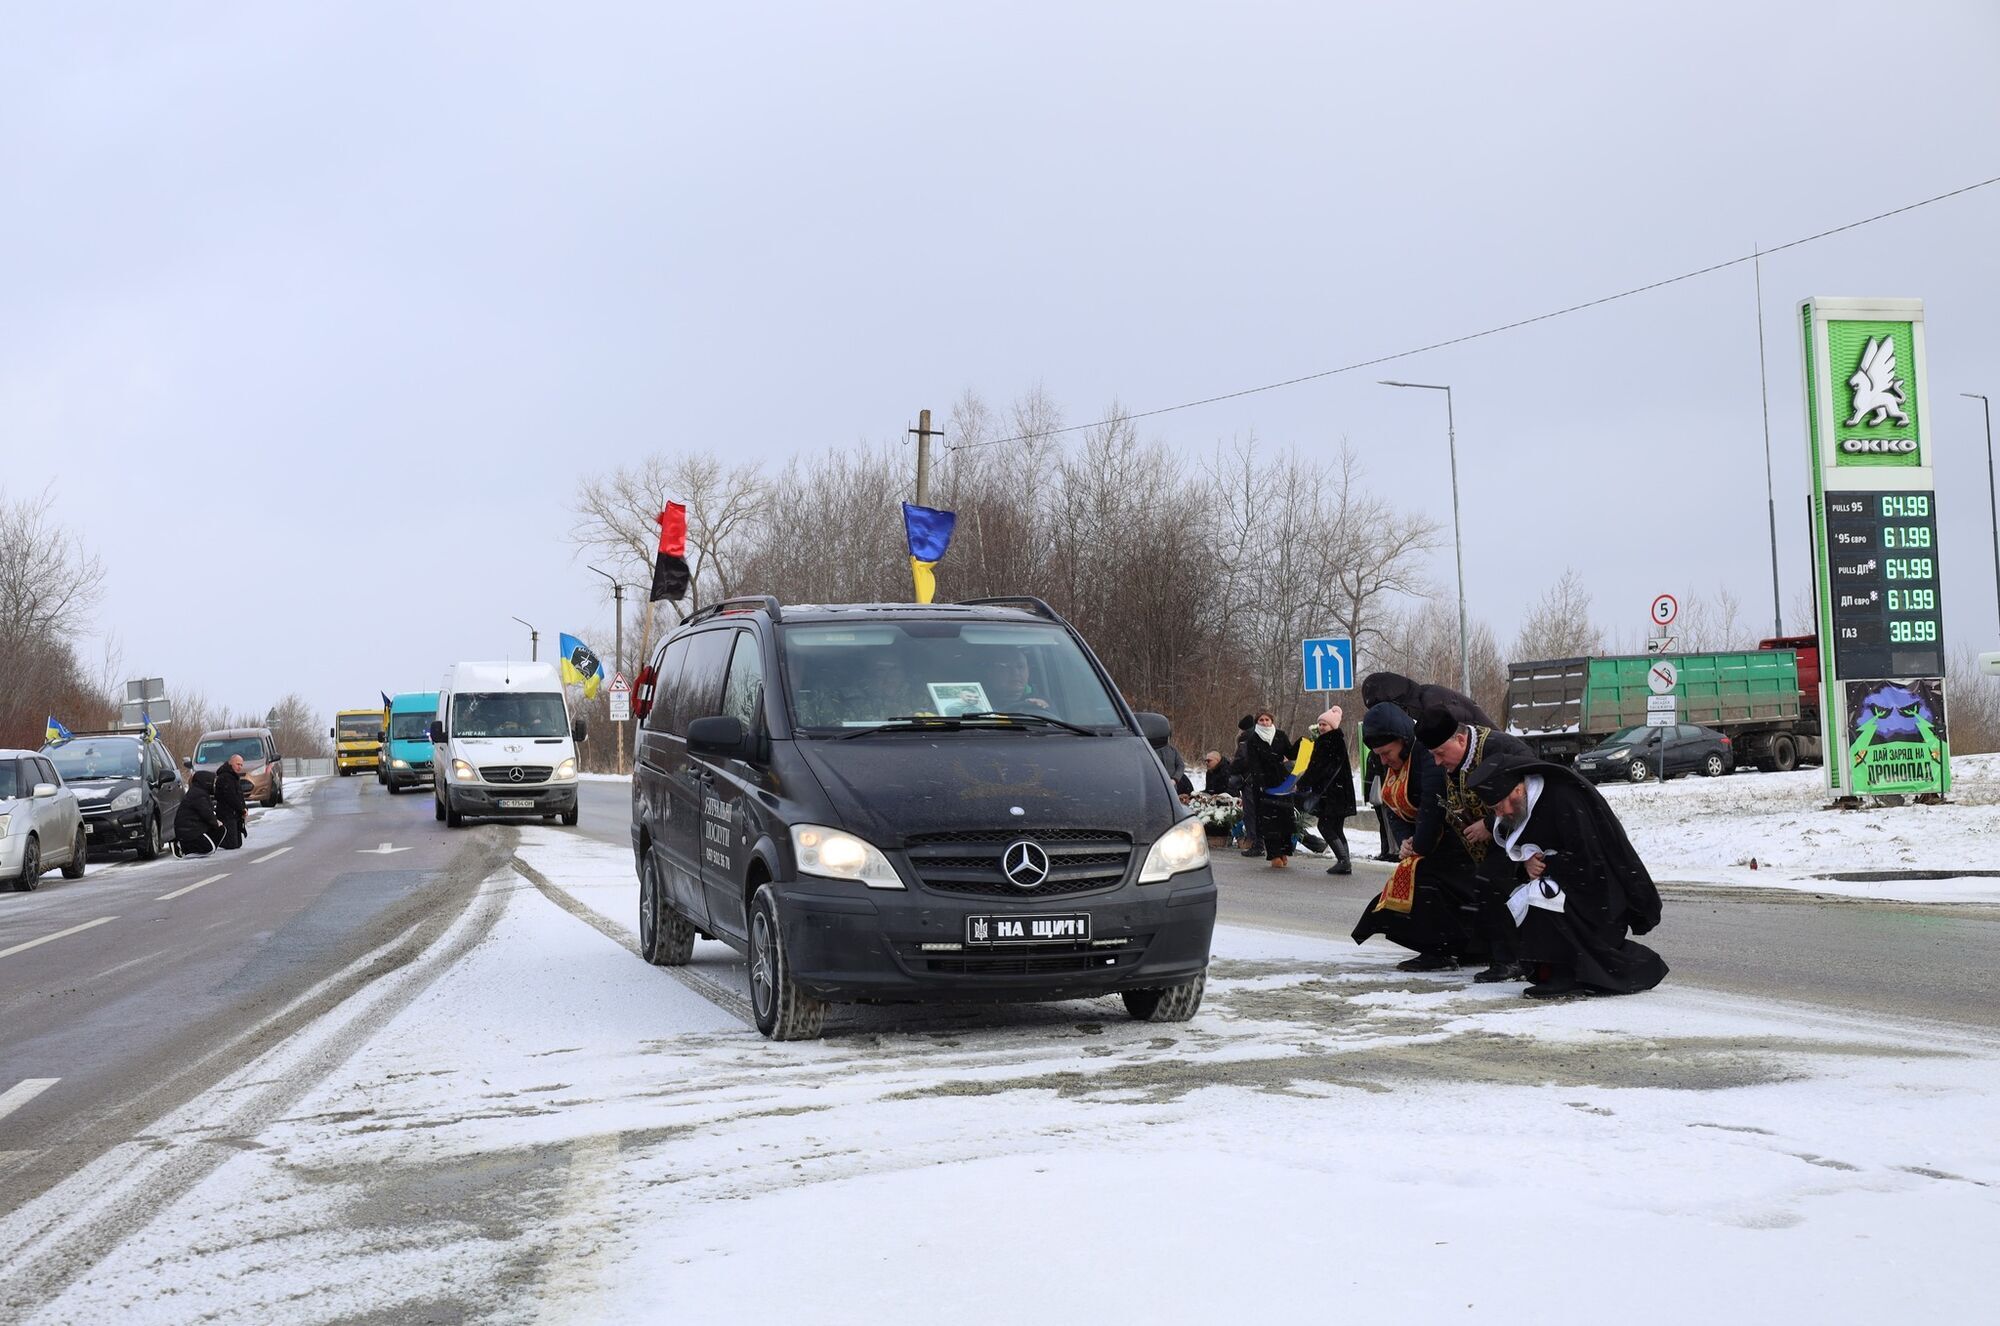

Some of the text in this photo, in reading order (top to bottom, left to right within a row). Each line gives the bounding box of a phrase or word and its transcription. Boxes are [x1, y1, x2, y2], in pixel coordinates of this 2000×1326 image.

[1843, 438, 1917, 453] OKKO
[1832, 496, 1928, 517] PULLS 95 64.99
[1884, 527, 1930, 548] 61.99
[1838, 559, 1932, 580] PULLS ДП 64.99
[1660, 602, 1669, 618] 5
[1841, 595, 1853, 607] ДП
[1888, 589, 1934, 610] 61.99
[1841, 621, 1936, 642] ГАЗ 38.99
[1873, 747, 1925, 761] ДАЙ ЗАРЯД НА
[1867, 762, 1934, 785] ДРОНОПАД
[997, 919, 1085, 938] НА ЩИТІ
